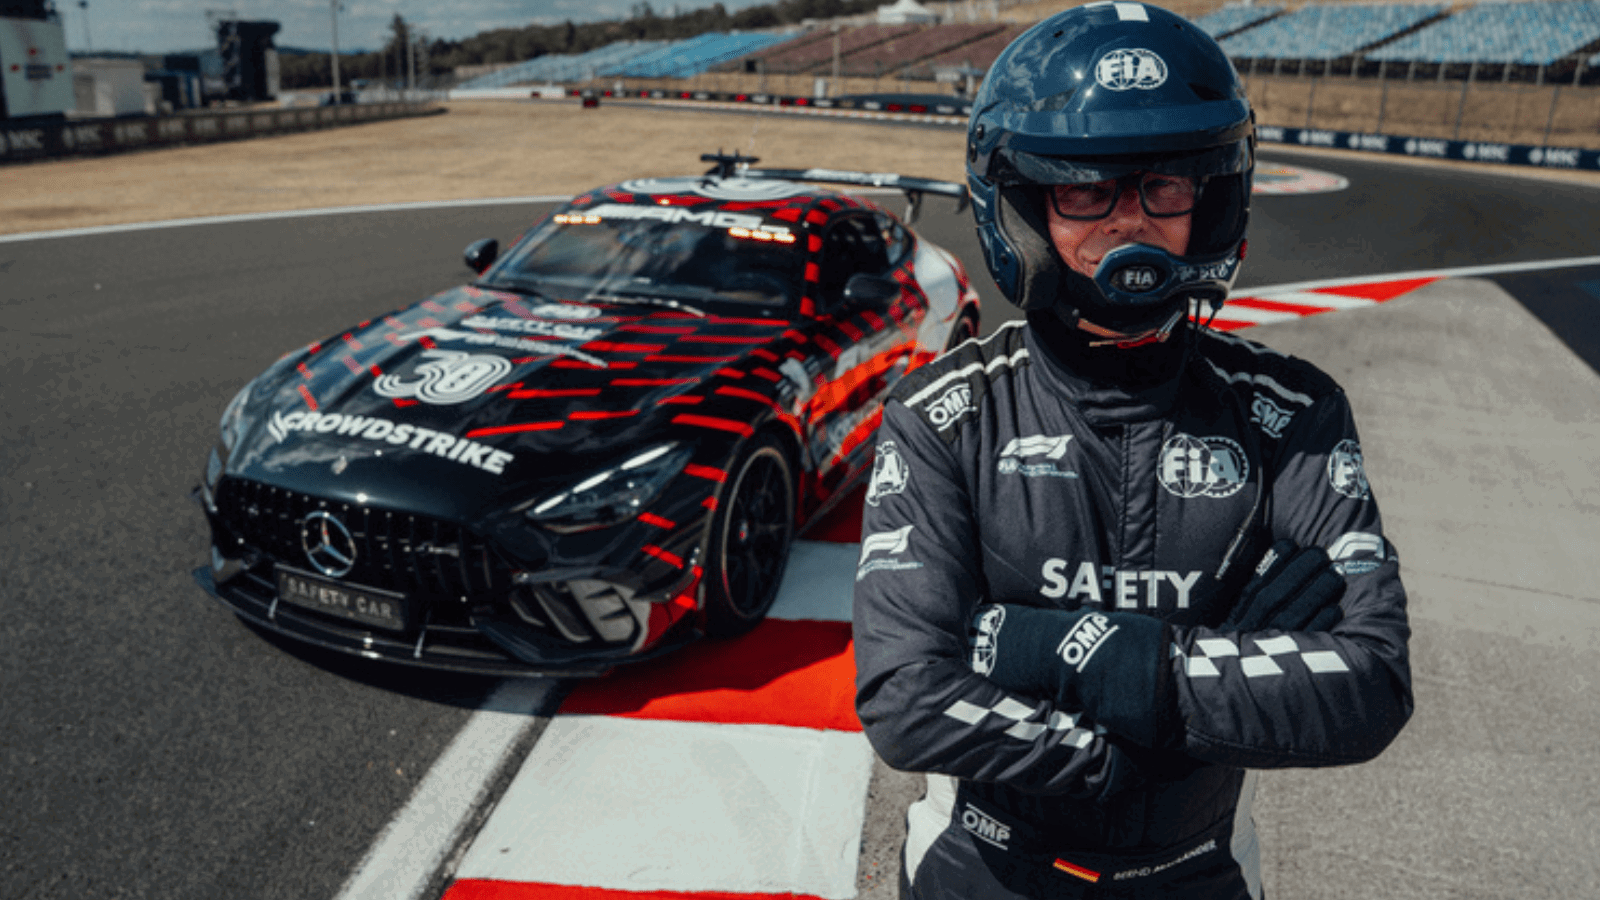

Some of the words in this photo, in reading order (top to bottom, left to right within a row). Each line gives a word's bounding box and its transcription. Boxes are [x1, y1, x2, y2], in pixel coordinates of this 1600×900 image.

[1099, 56, 1160, 82] FIA
[636, 204, 763, 230] AMG
[1124, 270, 1155, 286] FIA
[373, 350, 512, 405] 30
[929, 388, 973, 425] OMP
[1251, 399, 1292, 433] OMP
[282, 410, 515, 475] CROWDSTRIKE
[1161, 446, 1240, 484] FIA
[287, 577, 350, 608] SAFETY
[356, 595, 392, 619] CAR
[1039, 557, 1203, 609] SAFETY
[1062, 614, 1110, 665] OMP
[962, 810, 1011, 843] OMP
